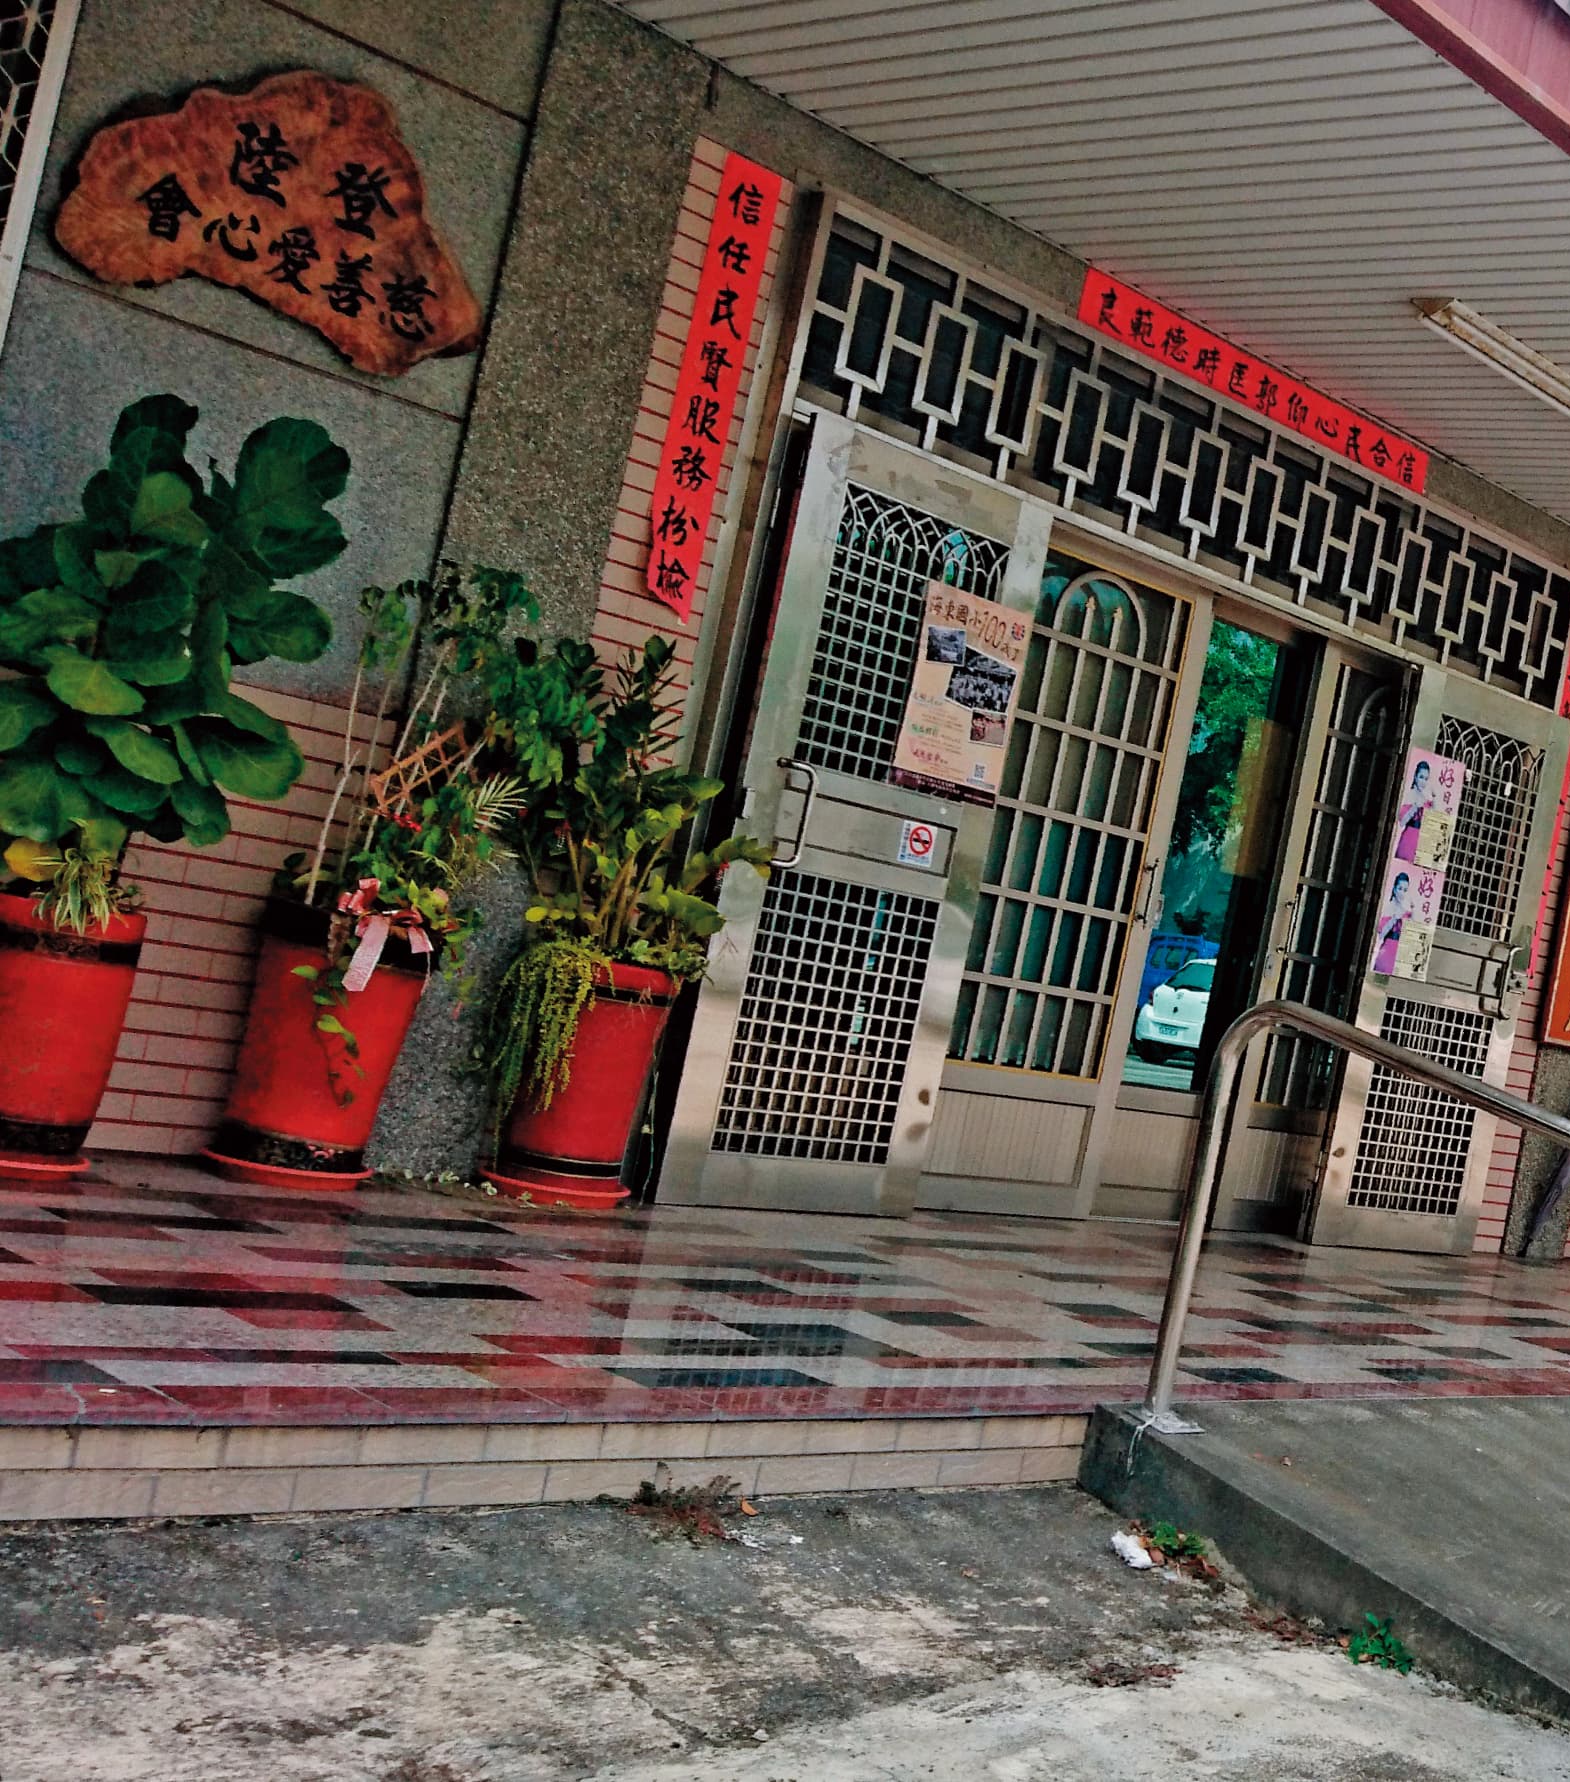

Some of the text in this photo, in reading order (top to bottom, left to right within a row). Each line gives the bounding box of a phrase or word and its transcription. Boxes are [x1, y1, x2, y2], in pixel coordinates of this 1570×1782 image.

[230, 122, 399, 241] 登陸
[137, 173, 438, 343] 慈善愛心會
